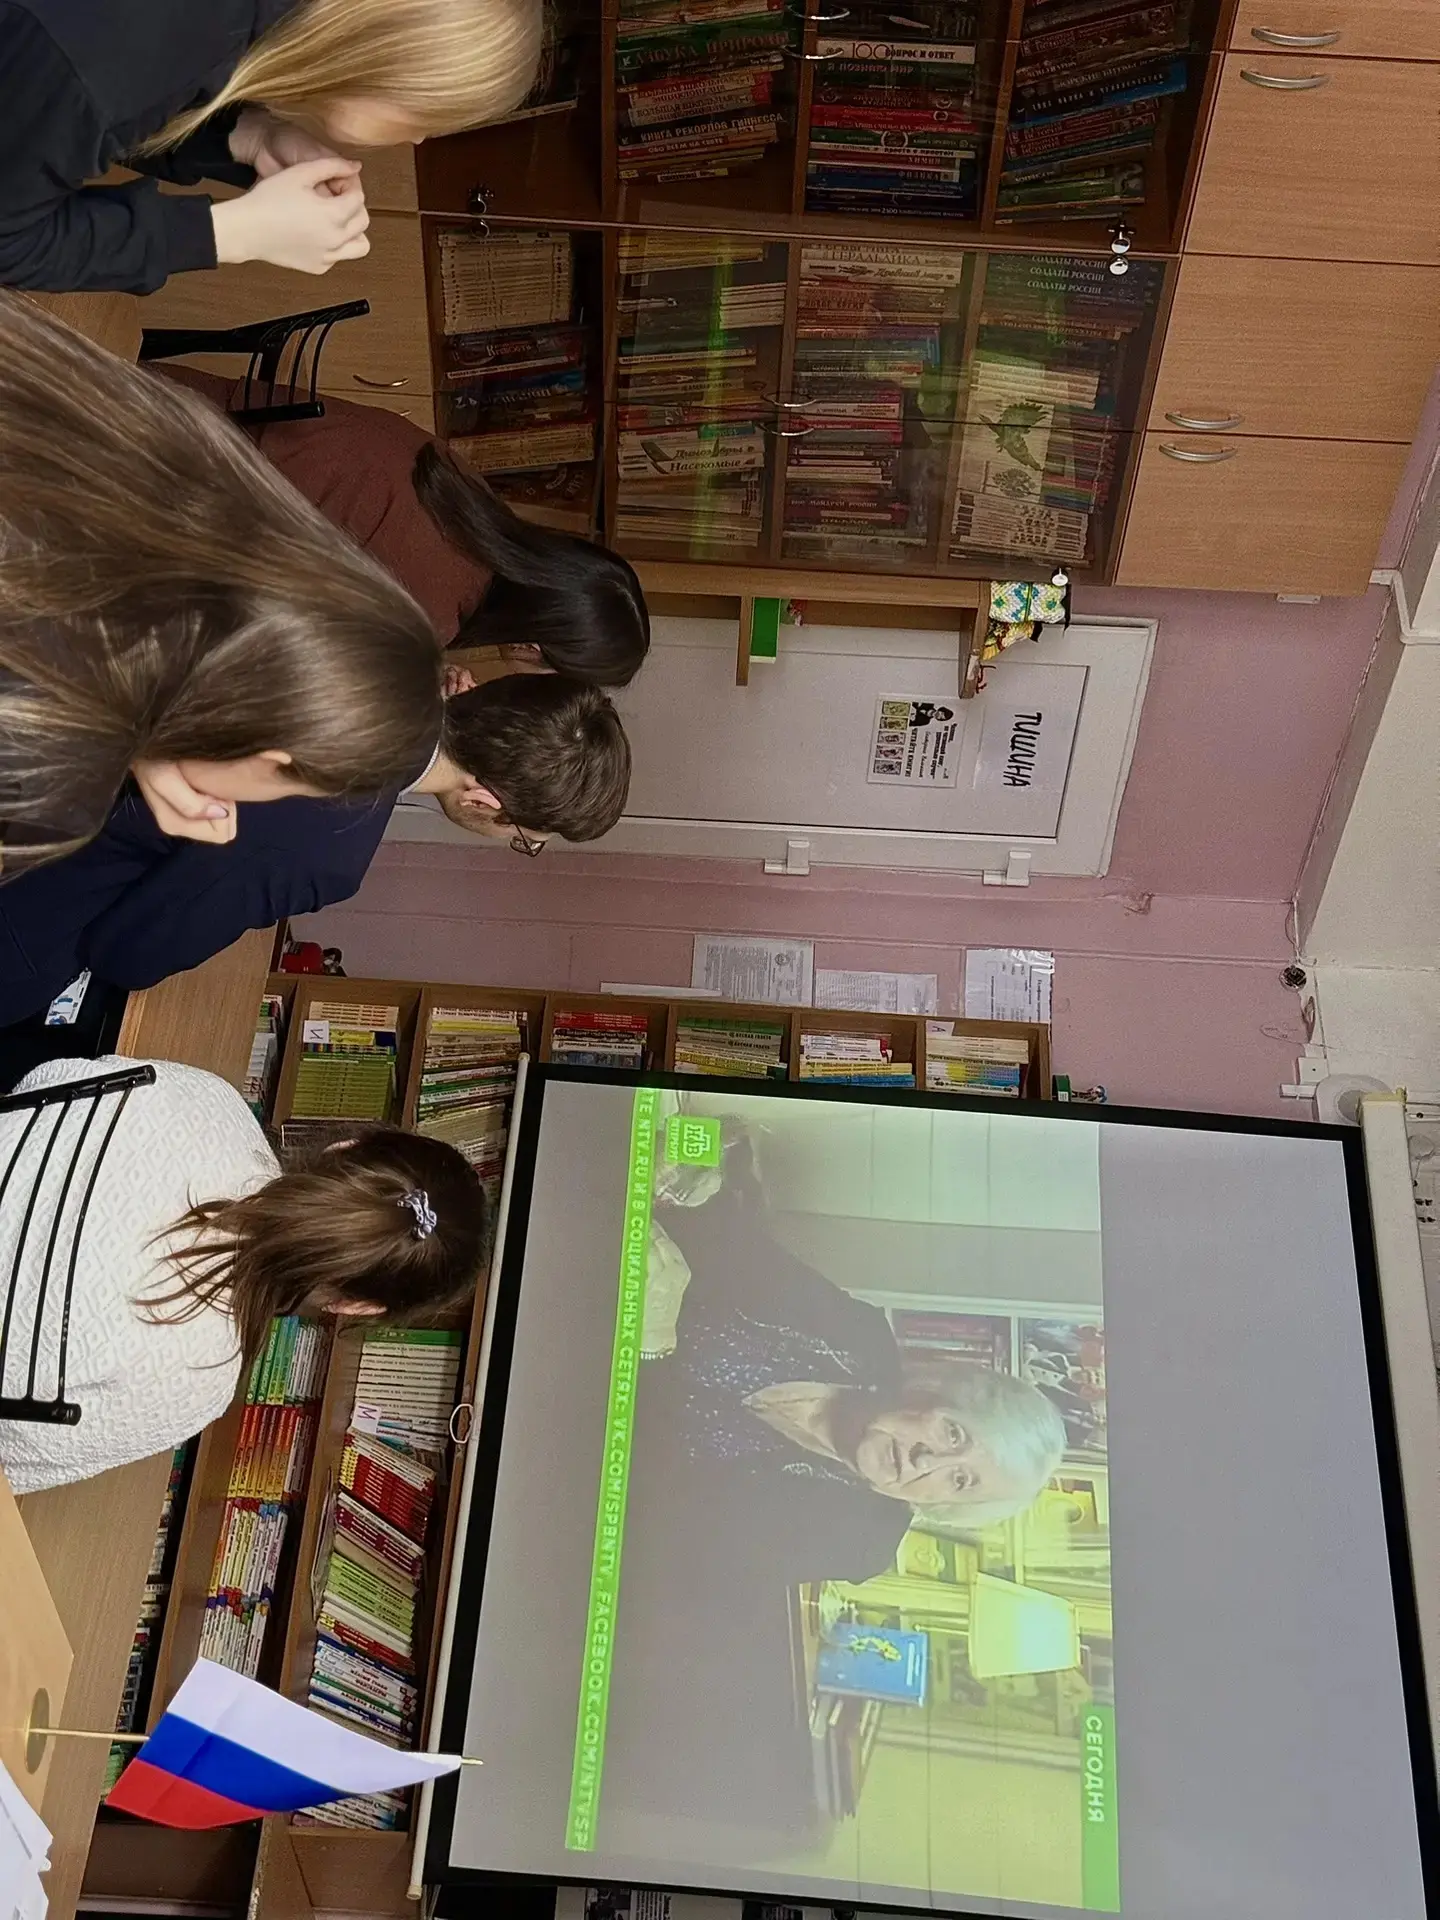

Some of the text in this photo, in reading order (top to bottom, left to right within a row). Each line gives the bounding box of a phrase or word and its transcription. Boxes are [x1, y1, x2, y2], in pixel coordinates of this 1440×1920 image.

[640, 113, 783, 142] КНИГА РЕКОРДОВ ГИННЕССА
[1029, 267, 1105, 282] СОЛДАТЫ РОССИИ
[1026, 279, 1102, 294] СОЛДАТЫ РОССИИ
[673, 446, 743, 460] Динозвры
[669, 459, 741, 472] Насекомые
[1003, 712, 1042, 788] ТИШИНА
[635, 1119, 652, 1178] NTV.RU
[686, 1126, 708, 1157] НТВ
[633, 1182, 649, 1195] И
[634, 1200, 646, 1209] В
[620, 1216, 644, 1340] СОЦИАЛЬНЫХ
[613, 1346, 634, 1412] СЕТЯХ:
[358, 1405, 377, 1420] М
[1084, 1715, 1105, 1823] СЕГОДНЯ
